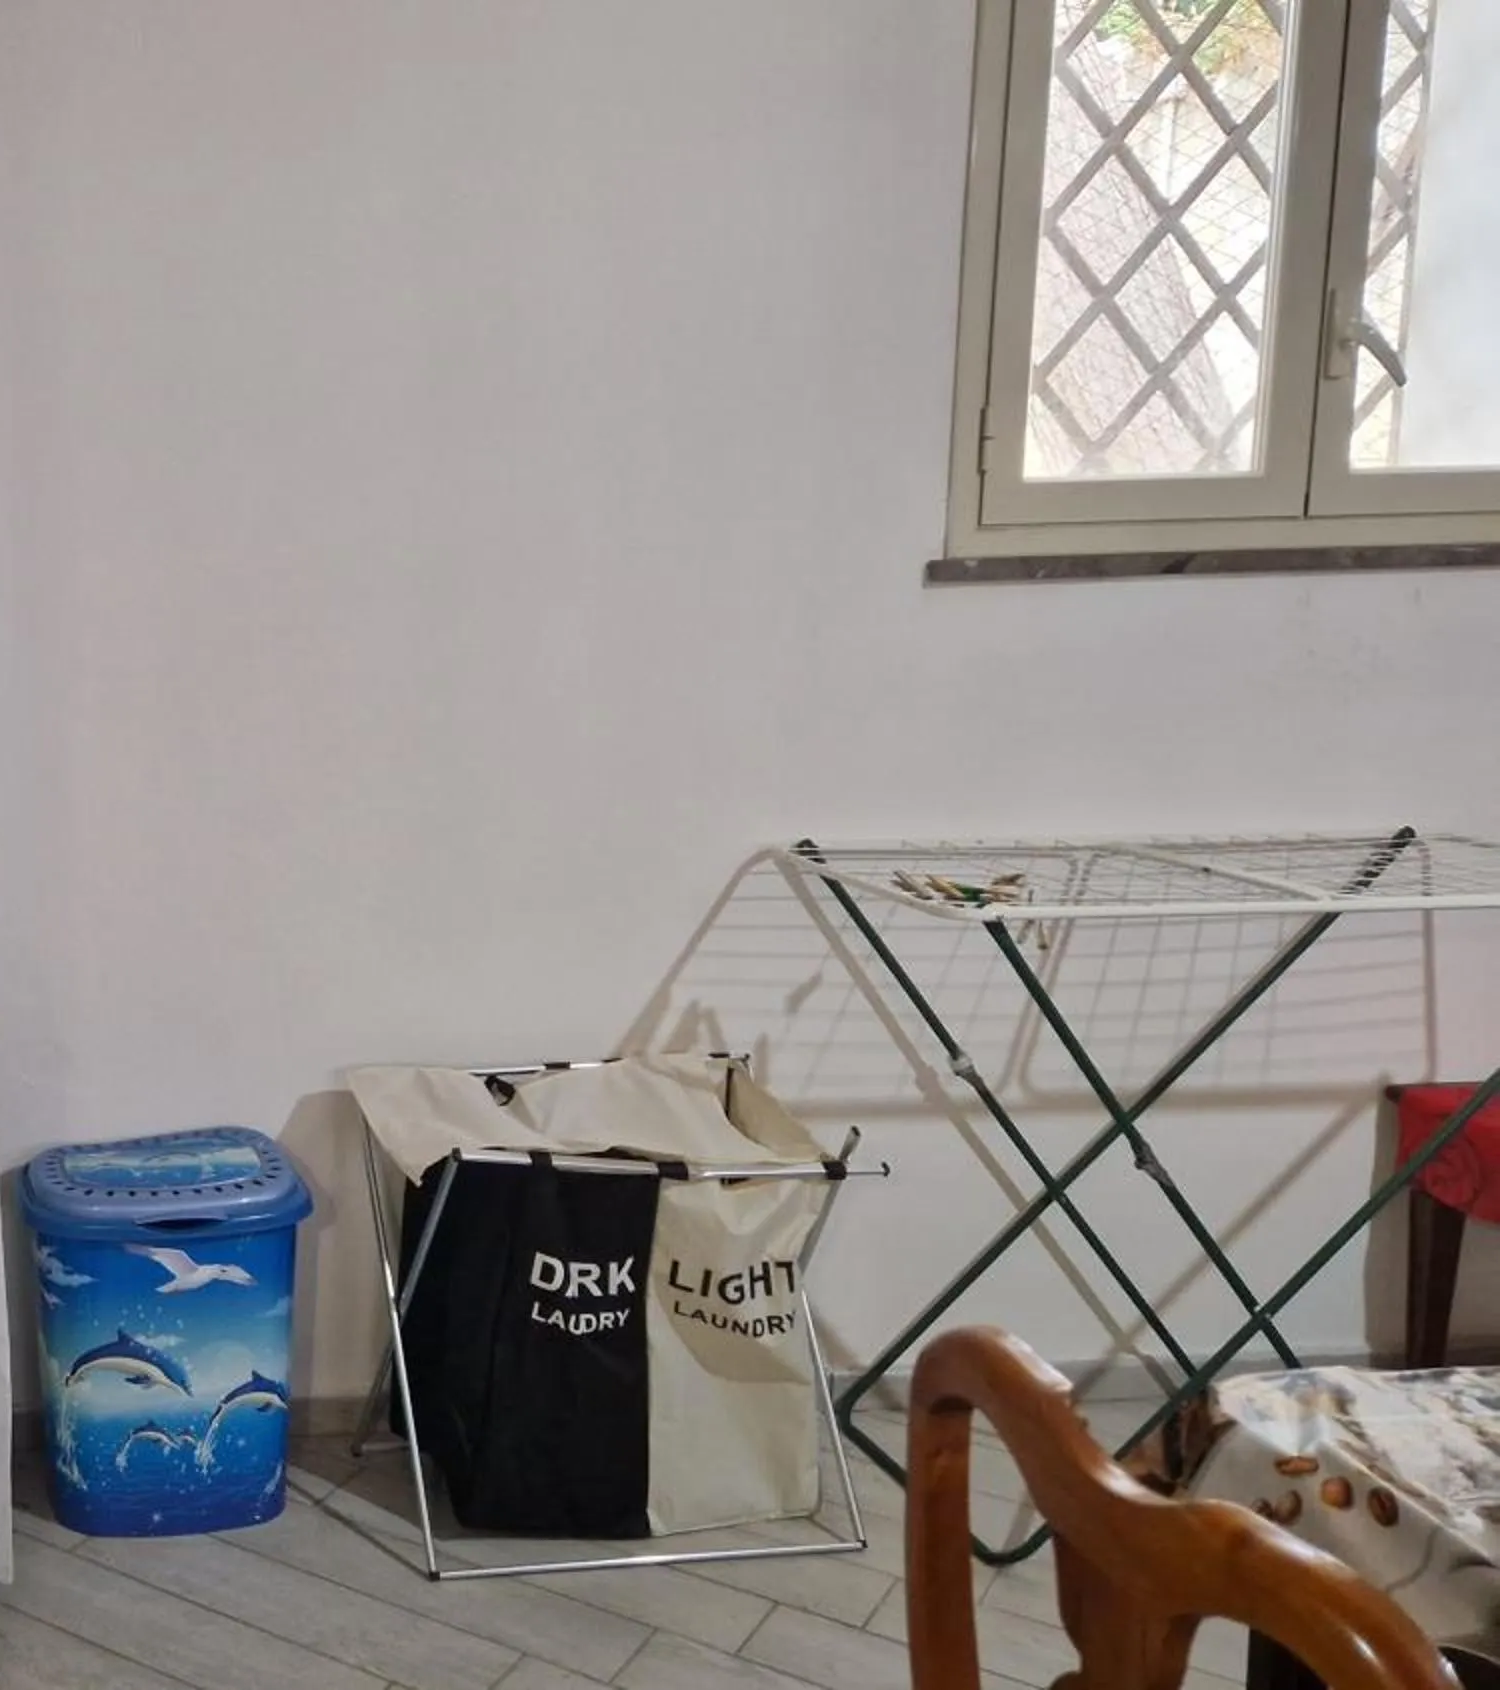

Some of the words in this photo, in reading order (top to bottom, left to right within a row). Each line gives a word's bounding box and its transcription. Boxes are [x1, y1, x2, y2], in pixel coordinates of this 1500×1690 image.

[531, 1252, 636, 1298] DRK
[668, 1260, 795, 1305] LIGHT
[531, 1301, 630, 1335] LAUDRY
[674, 1301, 796, 1338] LAUNDRY
